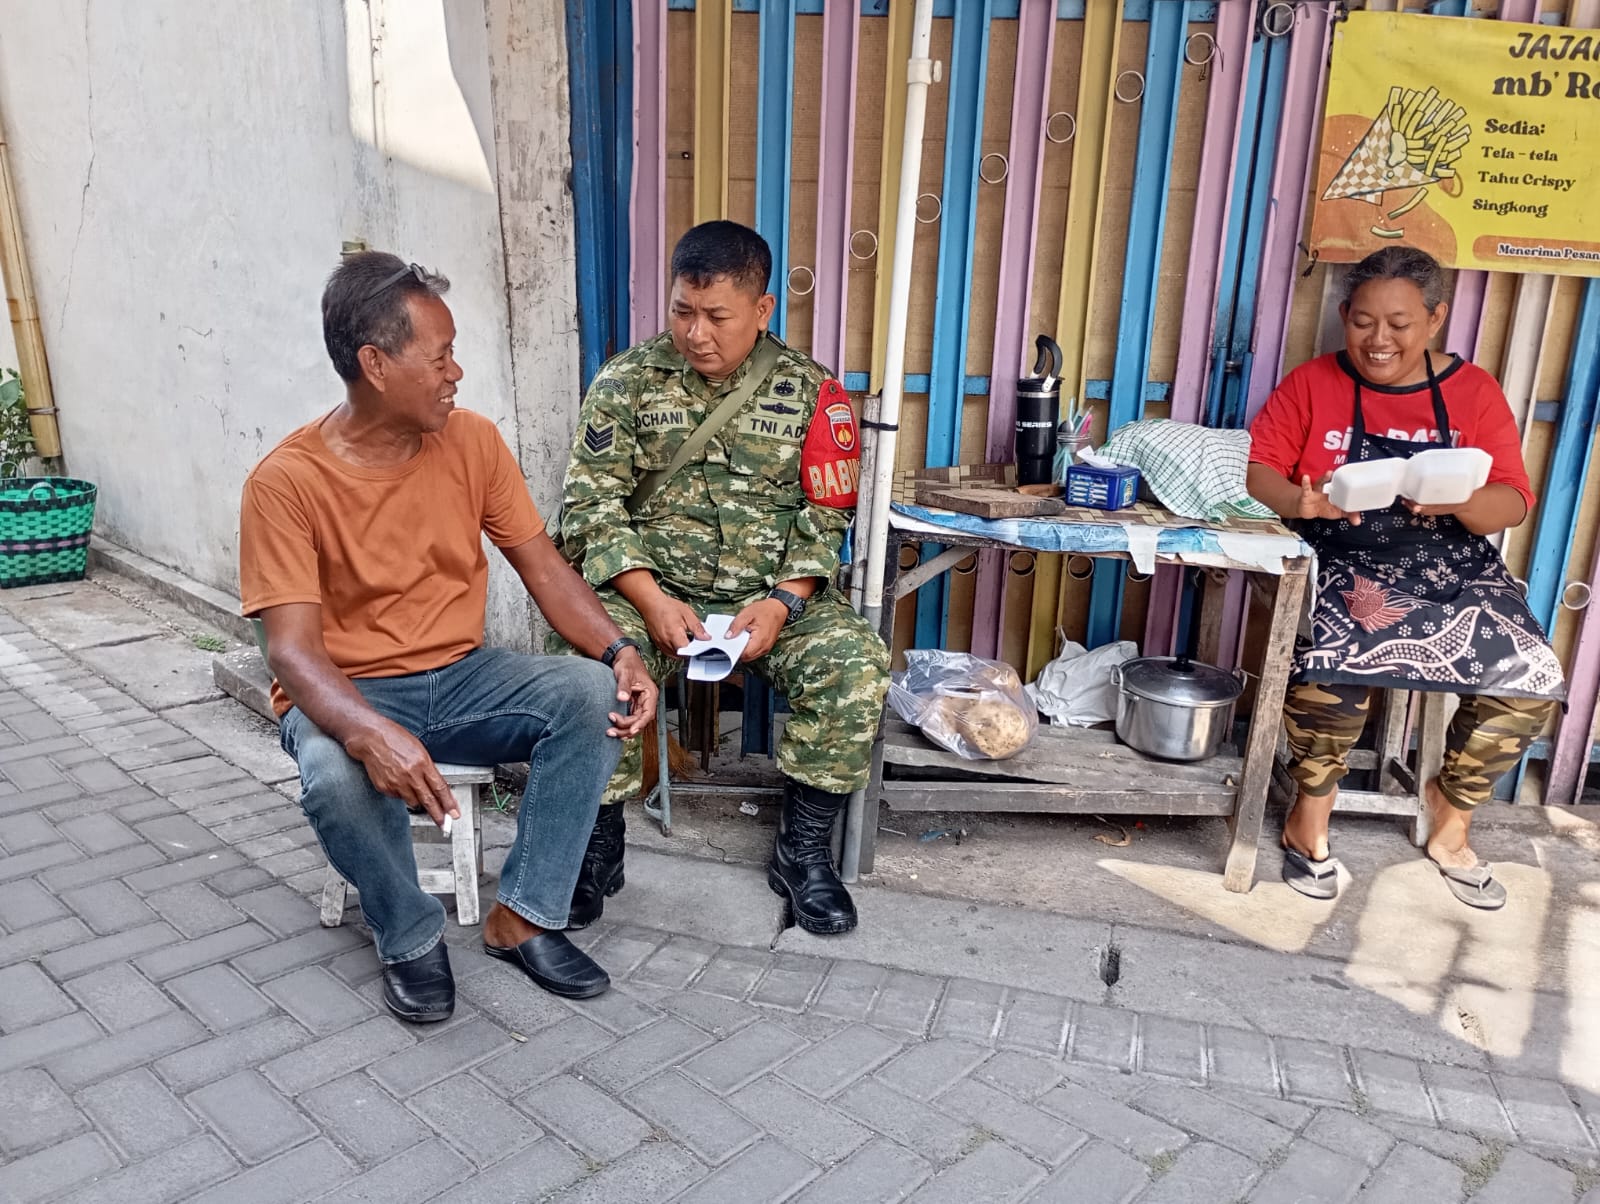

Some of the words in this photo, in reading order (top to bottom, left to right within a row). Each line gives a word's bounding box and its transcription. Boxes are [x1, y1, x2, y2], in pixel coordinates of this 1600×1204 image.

[1484, 118, 1545, 136] Sedia:
[1481, 146, 1515, 159] Tela
[1529, 150, 1558, 161] tela
[1478, 170, 1519, 184] Tahu
[1522, 173, 1576, 192] Crispy
[1472, 198, 1549, 218] Singkong
[1498, 243, 1562, 258] Menerima
[751, 418, 777, 434] TNI
